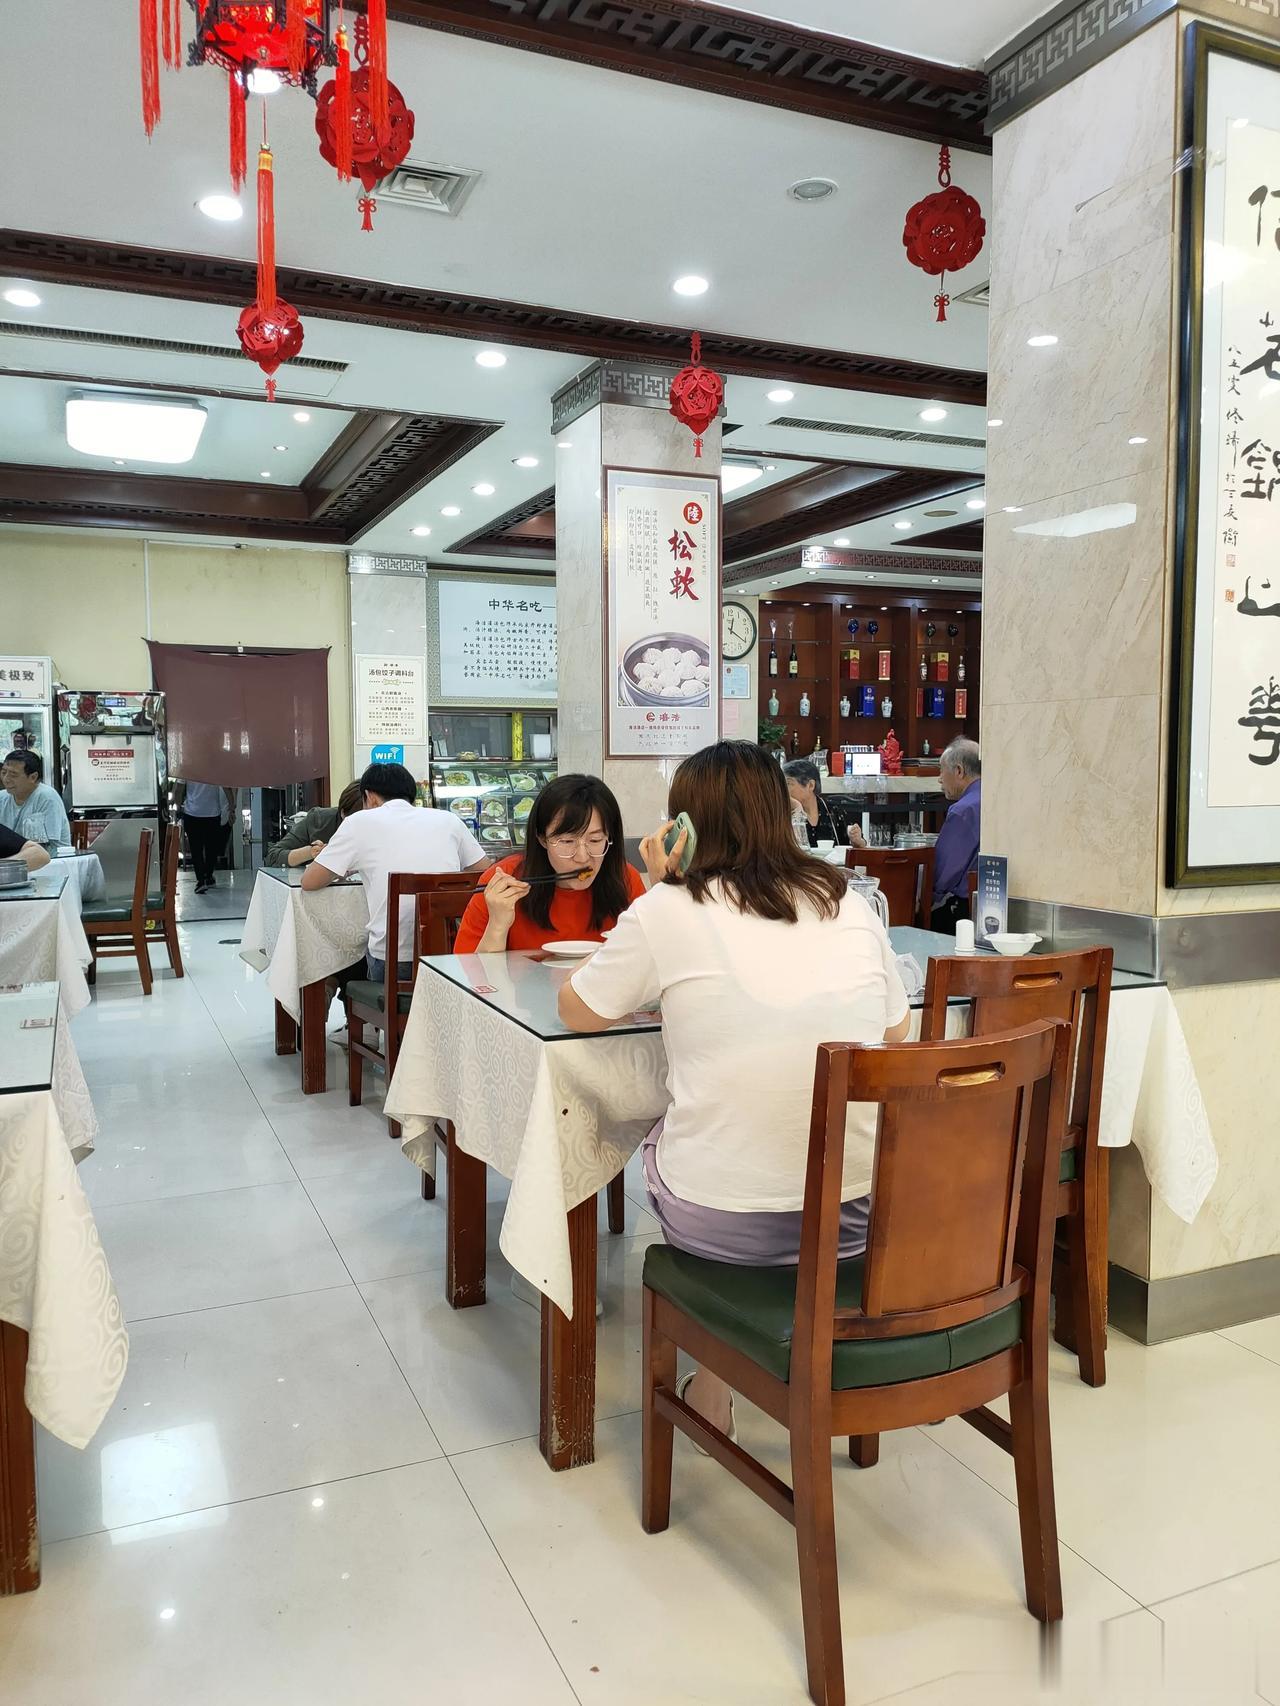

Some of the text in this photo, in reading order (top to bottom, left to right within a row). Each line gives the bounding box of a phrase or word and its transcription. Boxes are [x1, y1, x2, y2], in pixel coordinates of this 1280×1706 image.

[667, 528, 700, 601] 松軟
[488, 598, 543, 613] 中华名吃
